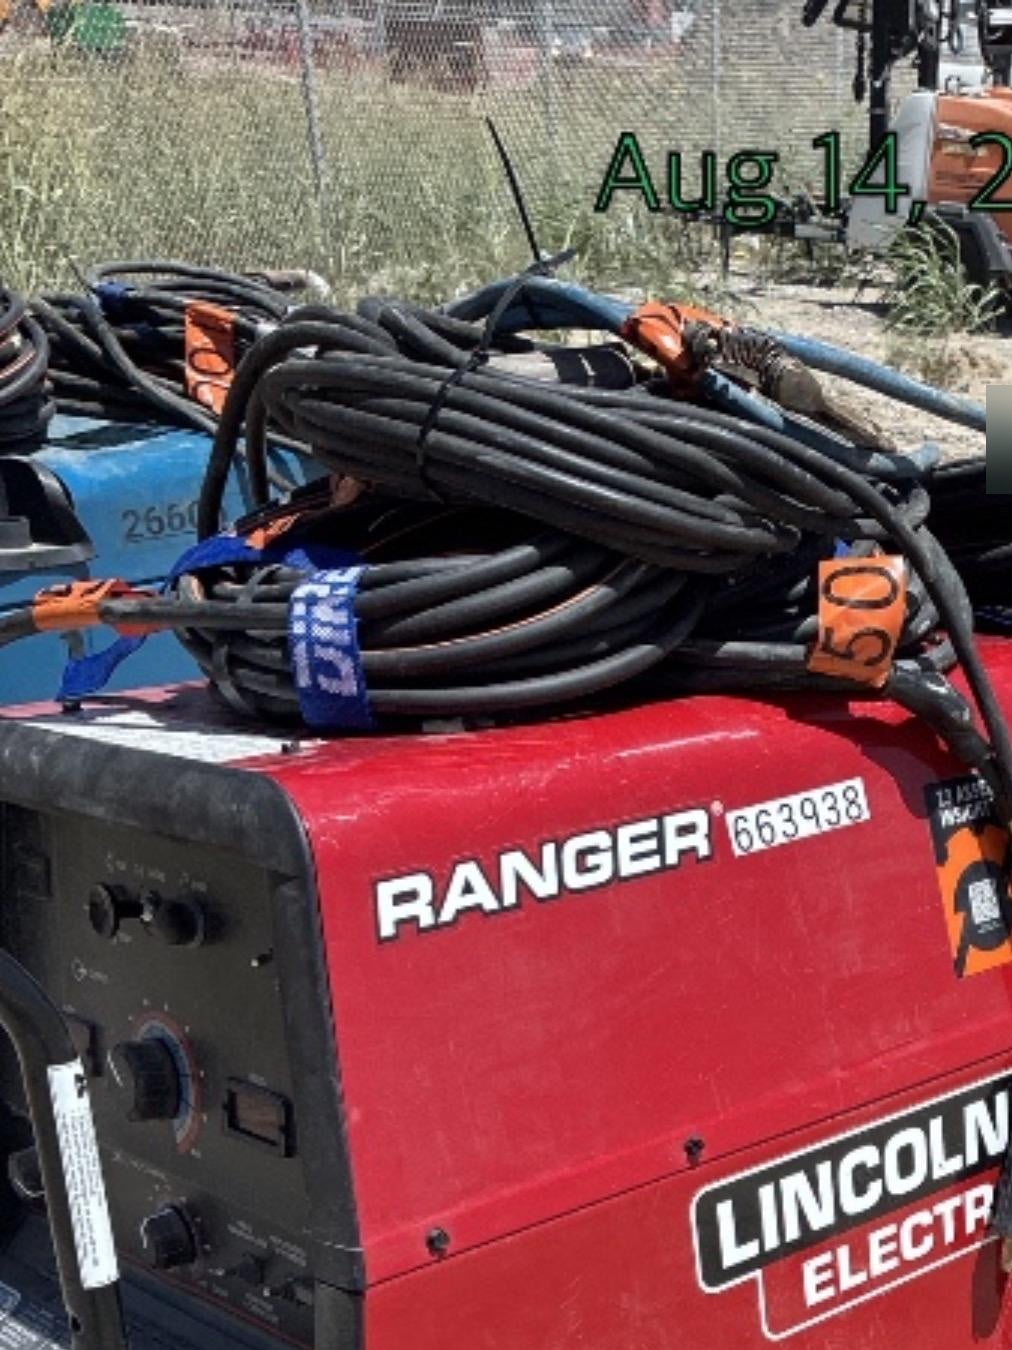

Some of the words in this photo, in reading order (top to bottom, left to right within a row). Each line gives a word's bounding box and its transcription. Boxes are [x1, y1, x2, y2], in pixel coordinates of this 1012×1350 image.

[822, 566, 899, 667] 50
[375, 808, 713, 944] RANGER
[733, 784, 864, 853] 663938
[716, 1091, 1011, 1269] LINCOLN
[803, 1183, 995, 1308] ELECTR
